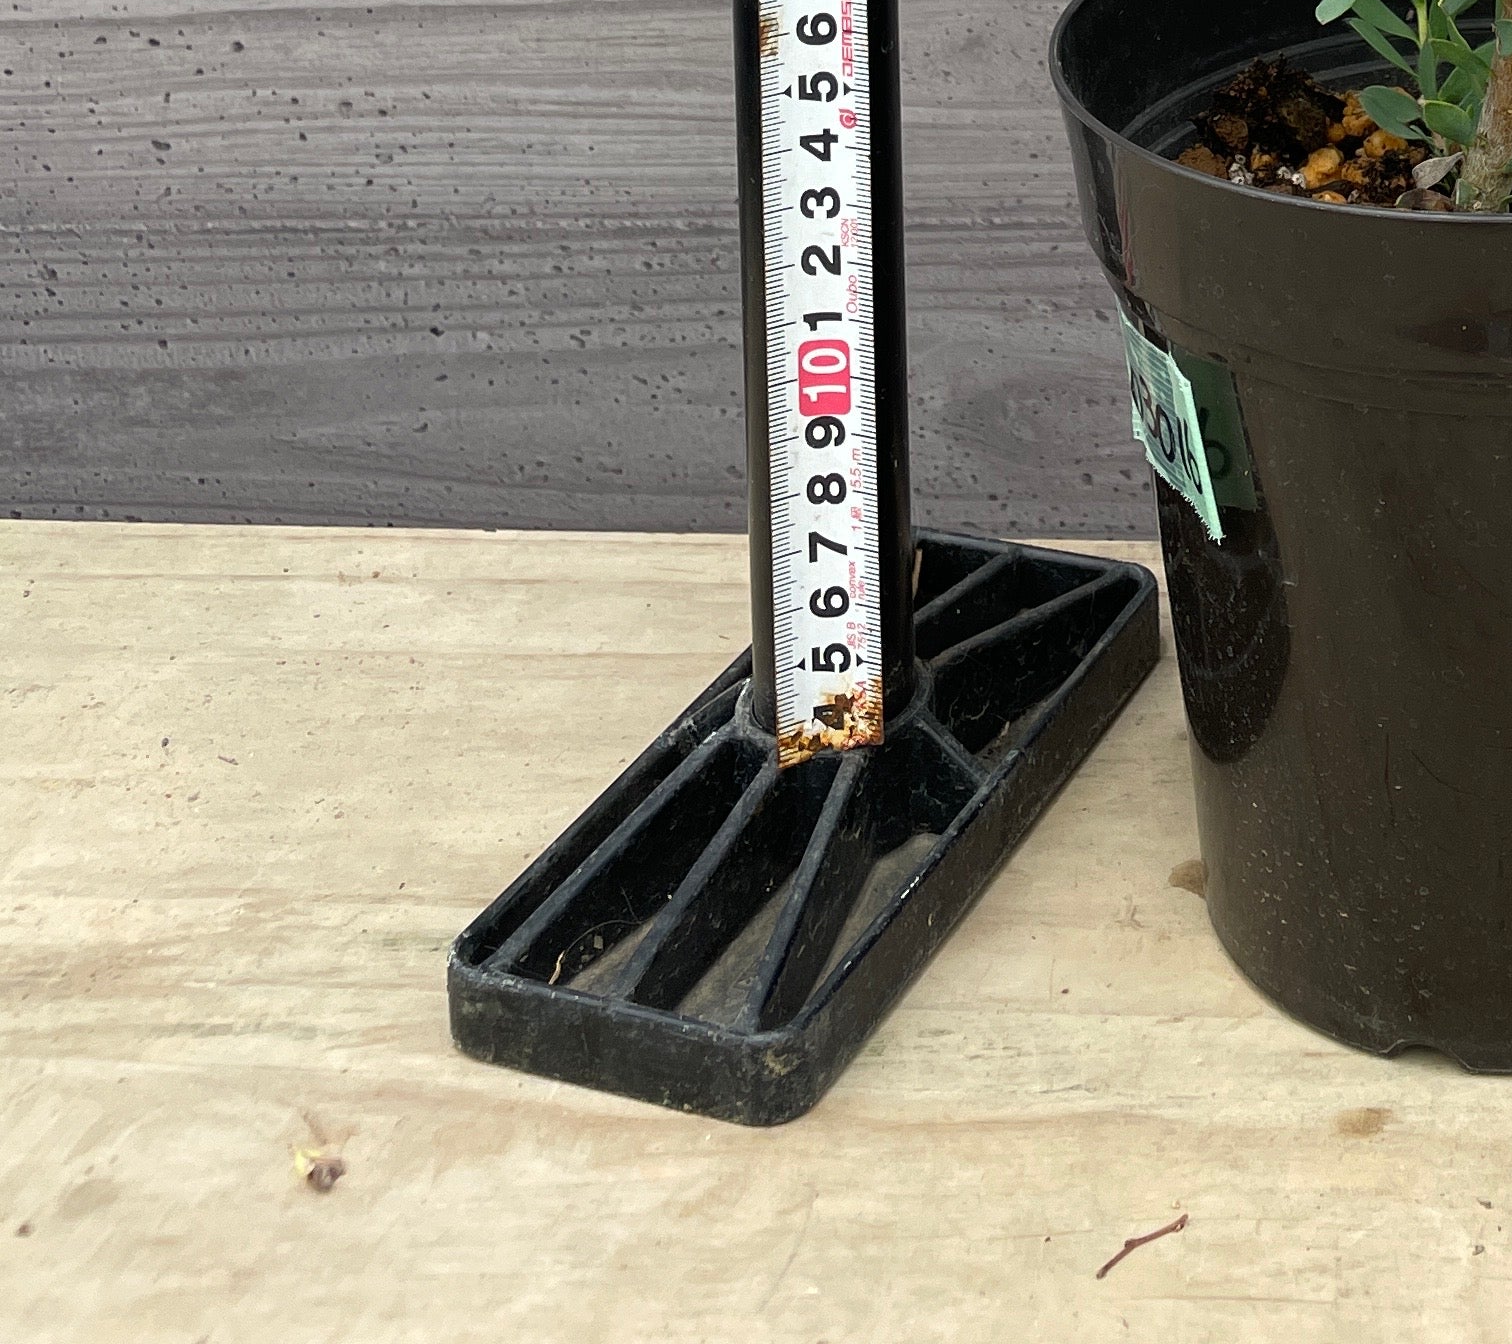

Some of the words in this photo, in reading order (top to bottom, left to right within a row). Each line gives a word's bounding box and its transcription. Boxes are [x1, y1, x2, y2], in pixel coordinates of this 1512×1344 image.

[795, 12, 838, 46] 6
[797, 71, 839, 103] 5
[799, 128, 839, 162] 4
[799, 186, 841, 219] 3
[800, 244, 842, 276] 2
[802, 311, 843, 332] 1
[802, 348, 847, 401] 10
[804, 415, 846, 449] 9
[806, 472, 847, 505] 8
[808, 531, 848, 564] 7
[808, 585, 850, 619] 6
[811, 642, 852, 674] 5
